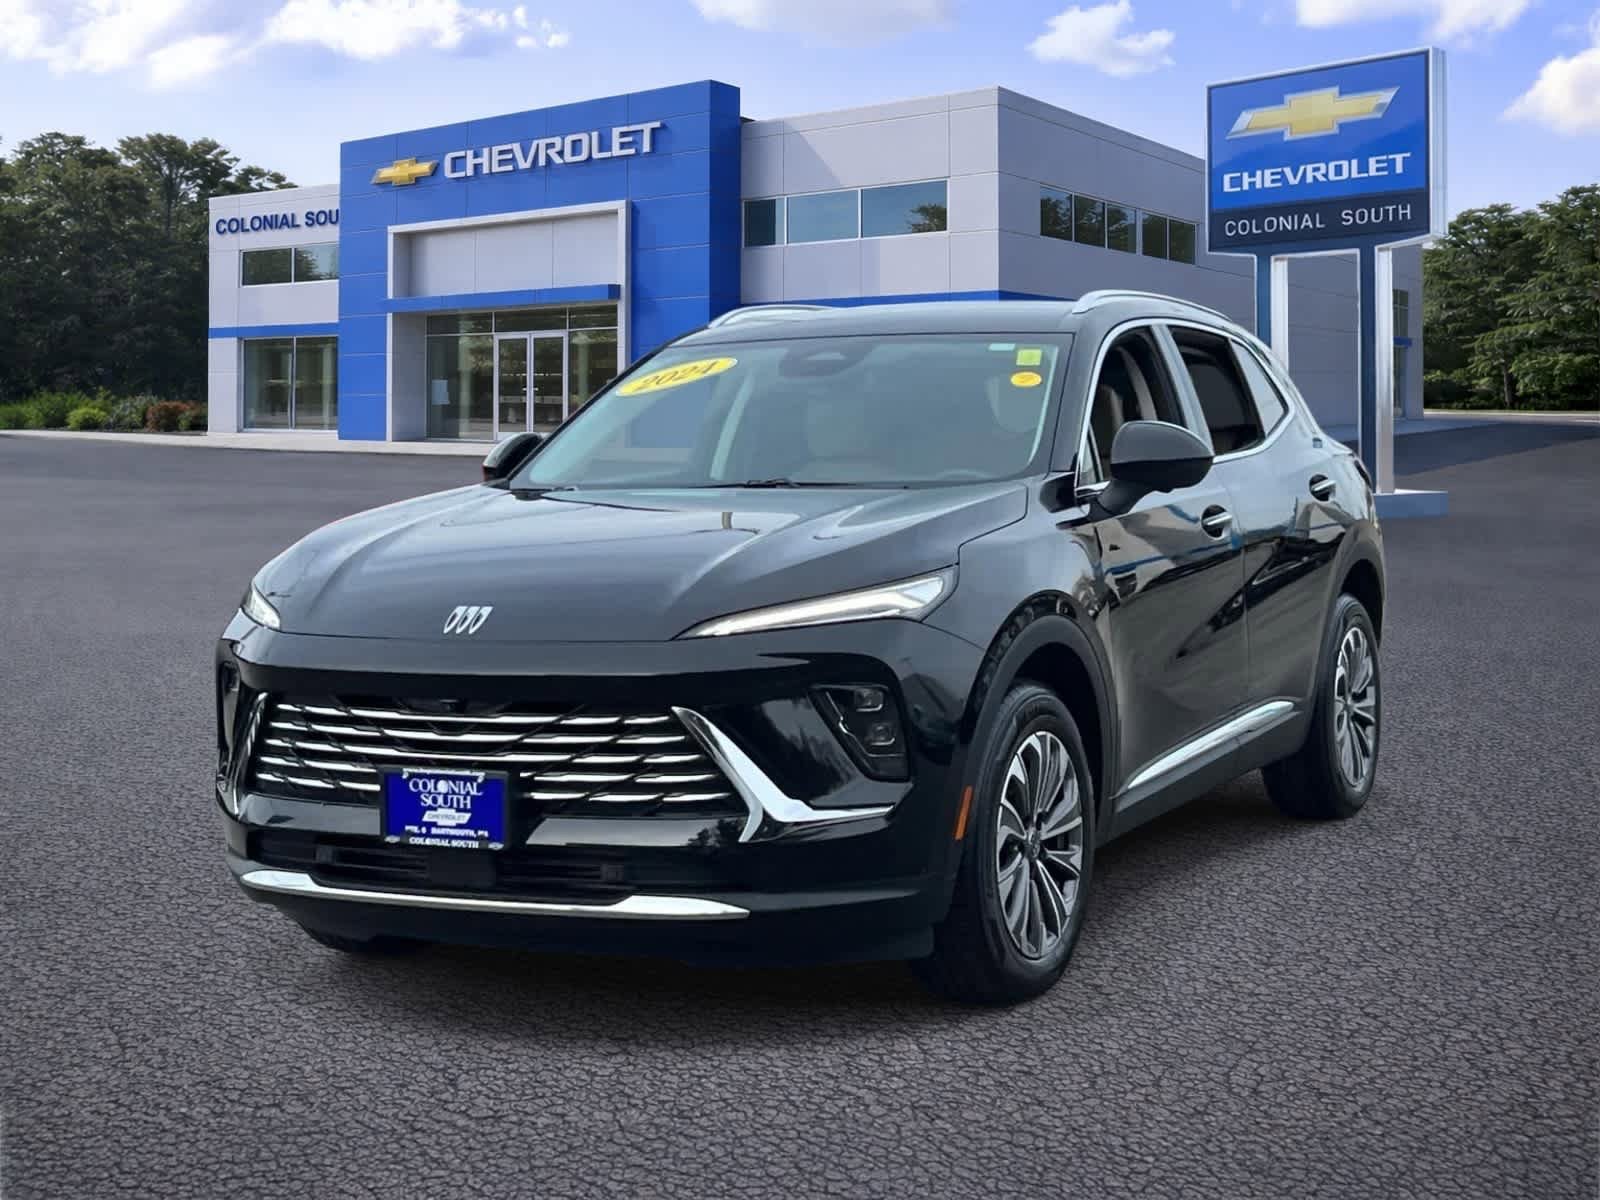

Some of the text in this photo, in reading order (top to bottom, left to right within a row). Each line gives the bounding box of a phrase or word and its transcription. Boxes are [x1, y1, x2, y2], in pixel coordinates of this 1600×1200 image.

[444, 121, 662, 179] CHEVROLET
[1223, 152, 1411, 193] CHEVROLET
[215, 208, 339, 234] COLONIAL SOU
[1224, 203, 1411, 237] COLONIAL SOUTH
[633, 360, 718, 391] 2024
[409, 778, 484, 796] COLONIAL
[420, 793, 471, 809] SOUTH
[409, 836, 480, 849] COLONIAL SOUTH
